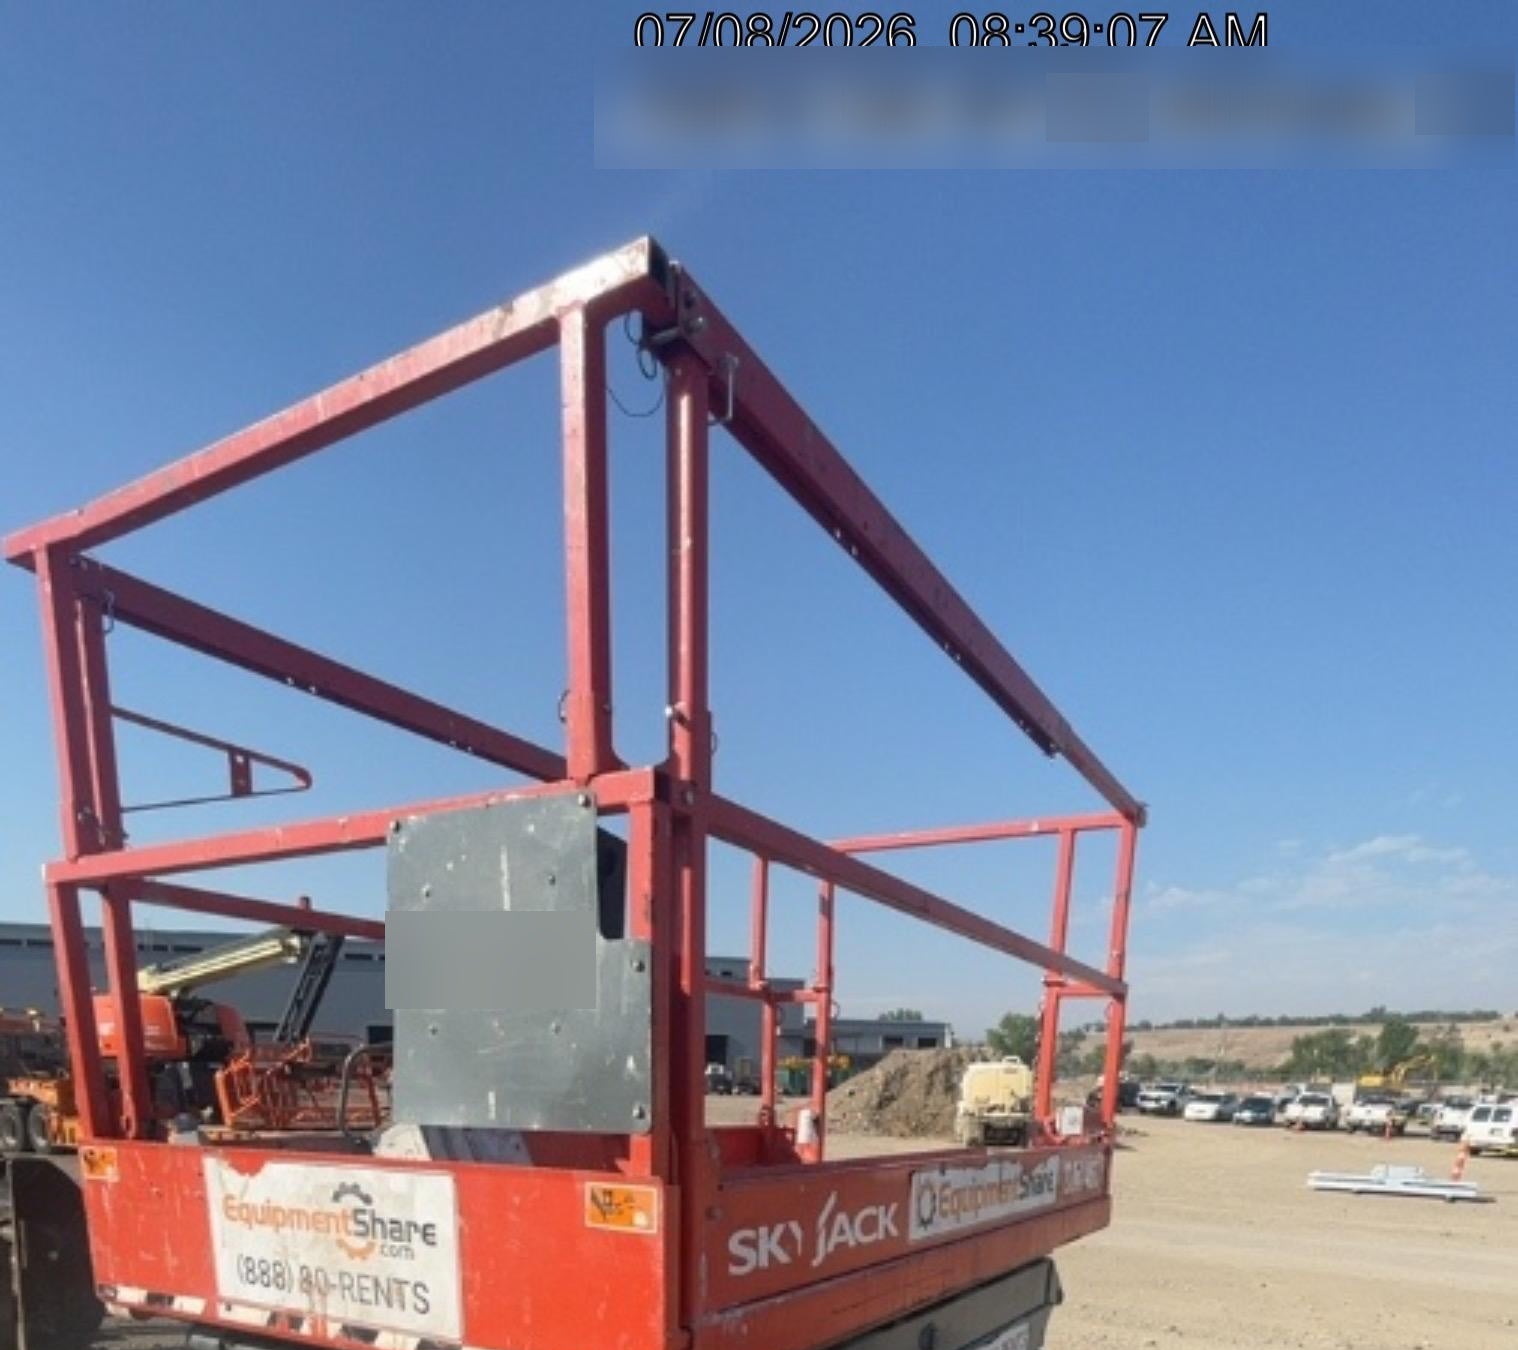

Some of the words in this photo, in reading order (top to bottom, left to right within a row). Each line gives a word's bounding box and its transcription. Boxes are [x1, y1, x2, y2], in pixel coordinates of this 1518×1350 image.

[222, 1194, 437, 1247] EquipmentShare
[236, 1253, 294, 1294] (888)
[299, 1264, 431, 1315] 80-RENTS
